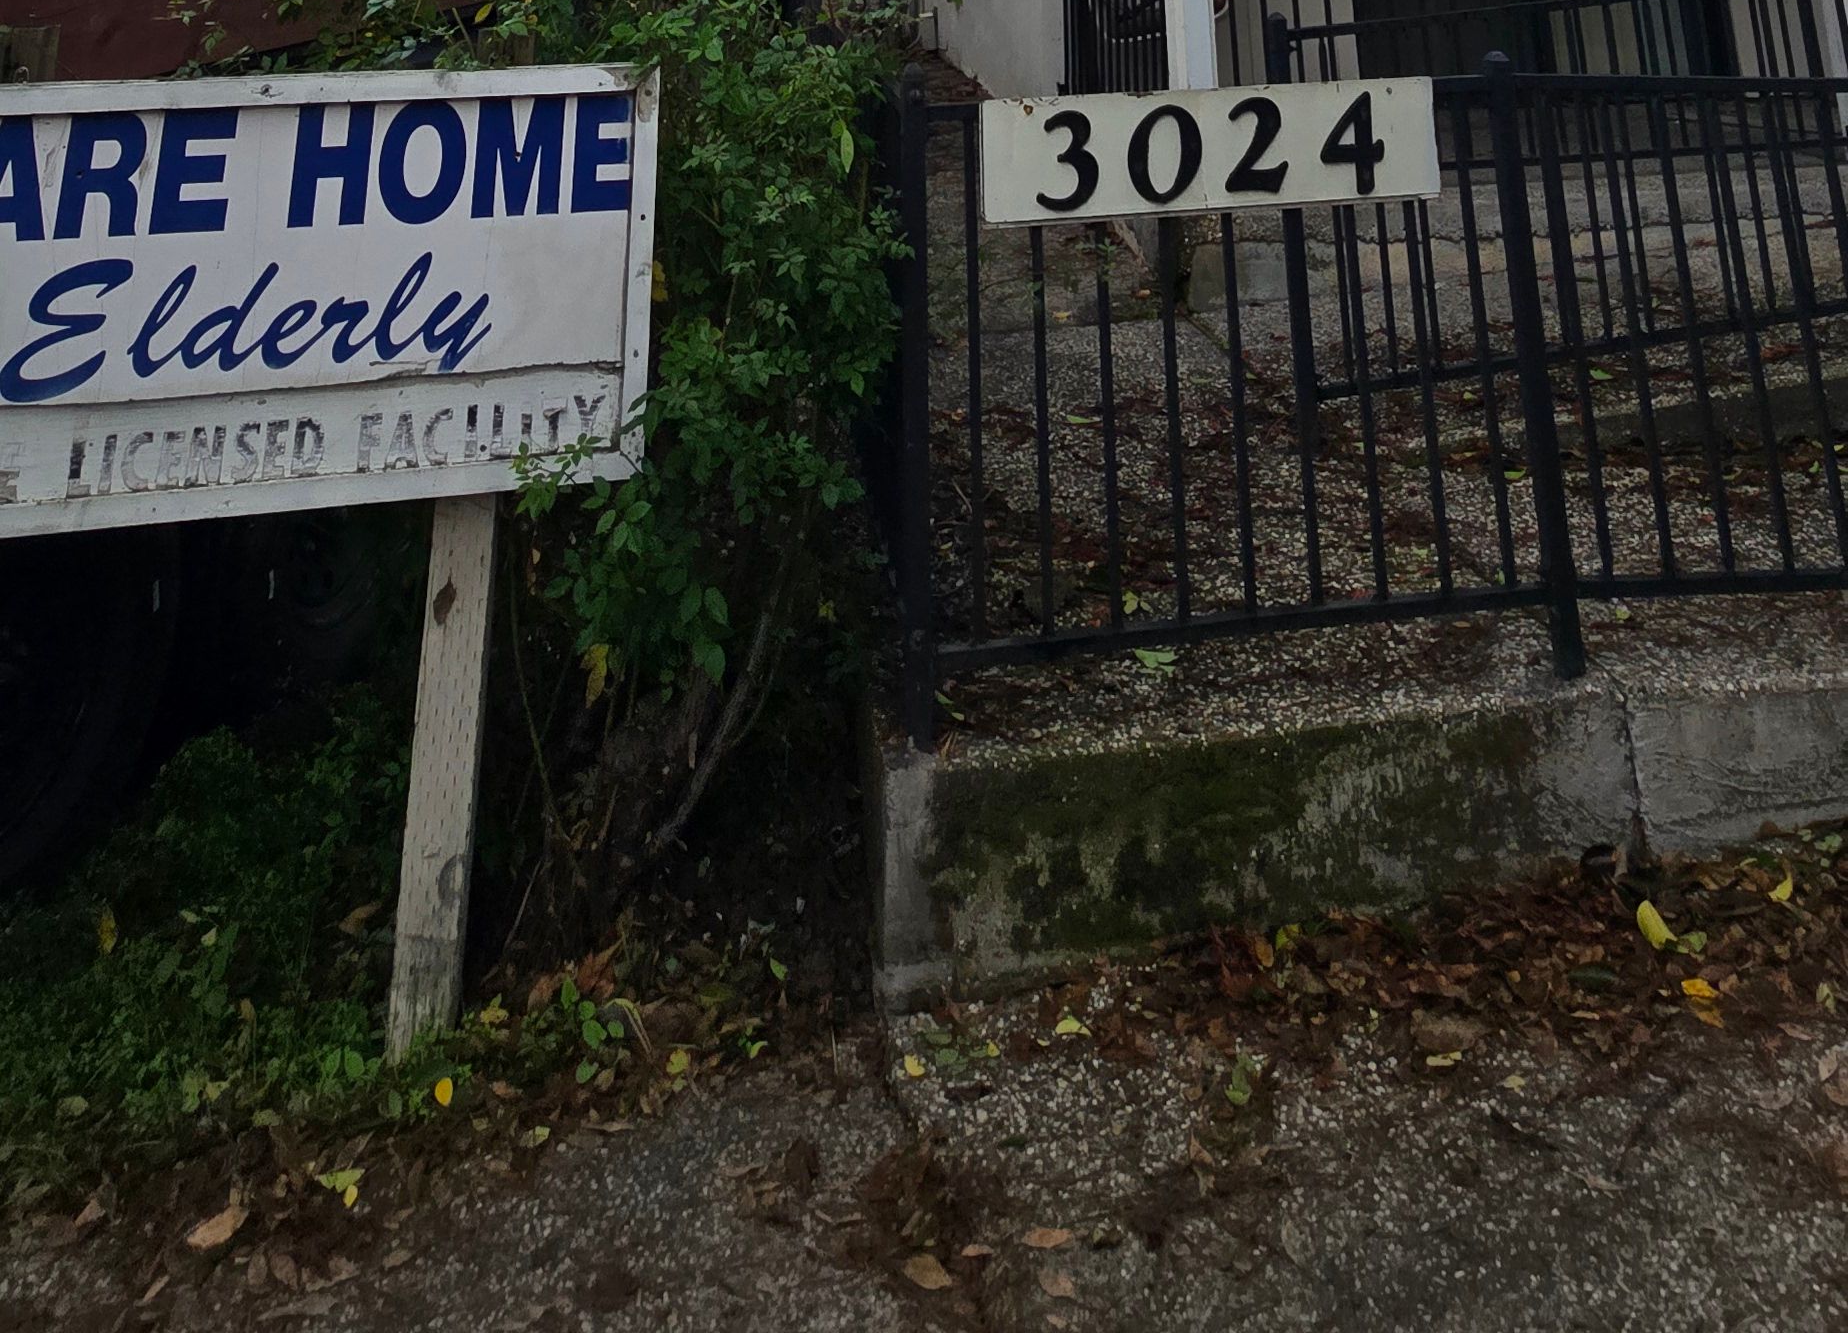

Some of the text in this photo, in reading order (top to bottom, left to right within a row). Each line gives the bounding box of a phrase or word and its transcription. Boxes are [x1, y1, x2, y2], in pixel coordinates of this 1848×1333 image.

[287, 96, 632, 228] HOME
[1036, 91, 1385, 212] 3024
[0, 251, 492, 403] Elderly
[66, 415, 325, 500] LICENSED
[356, 395, 606, 474] FACILITY
